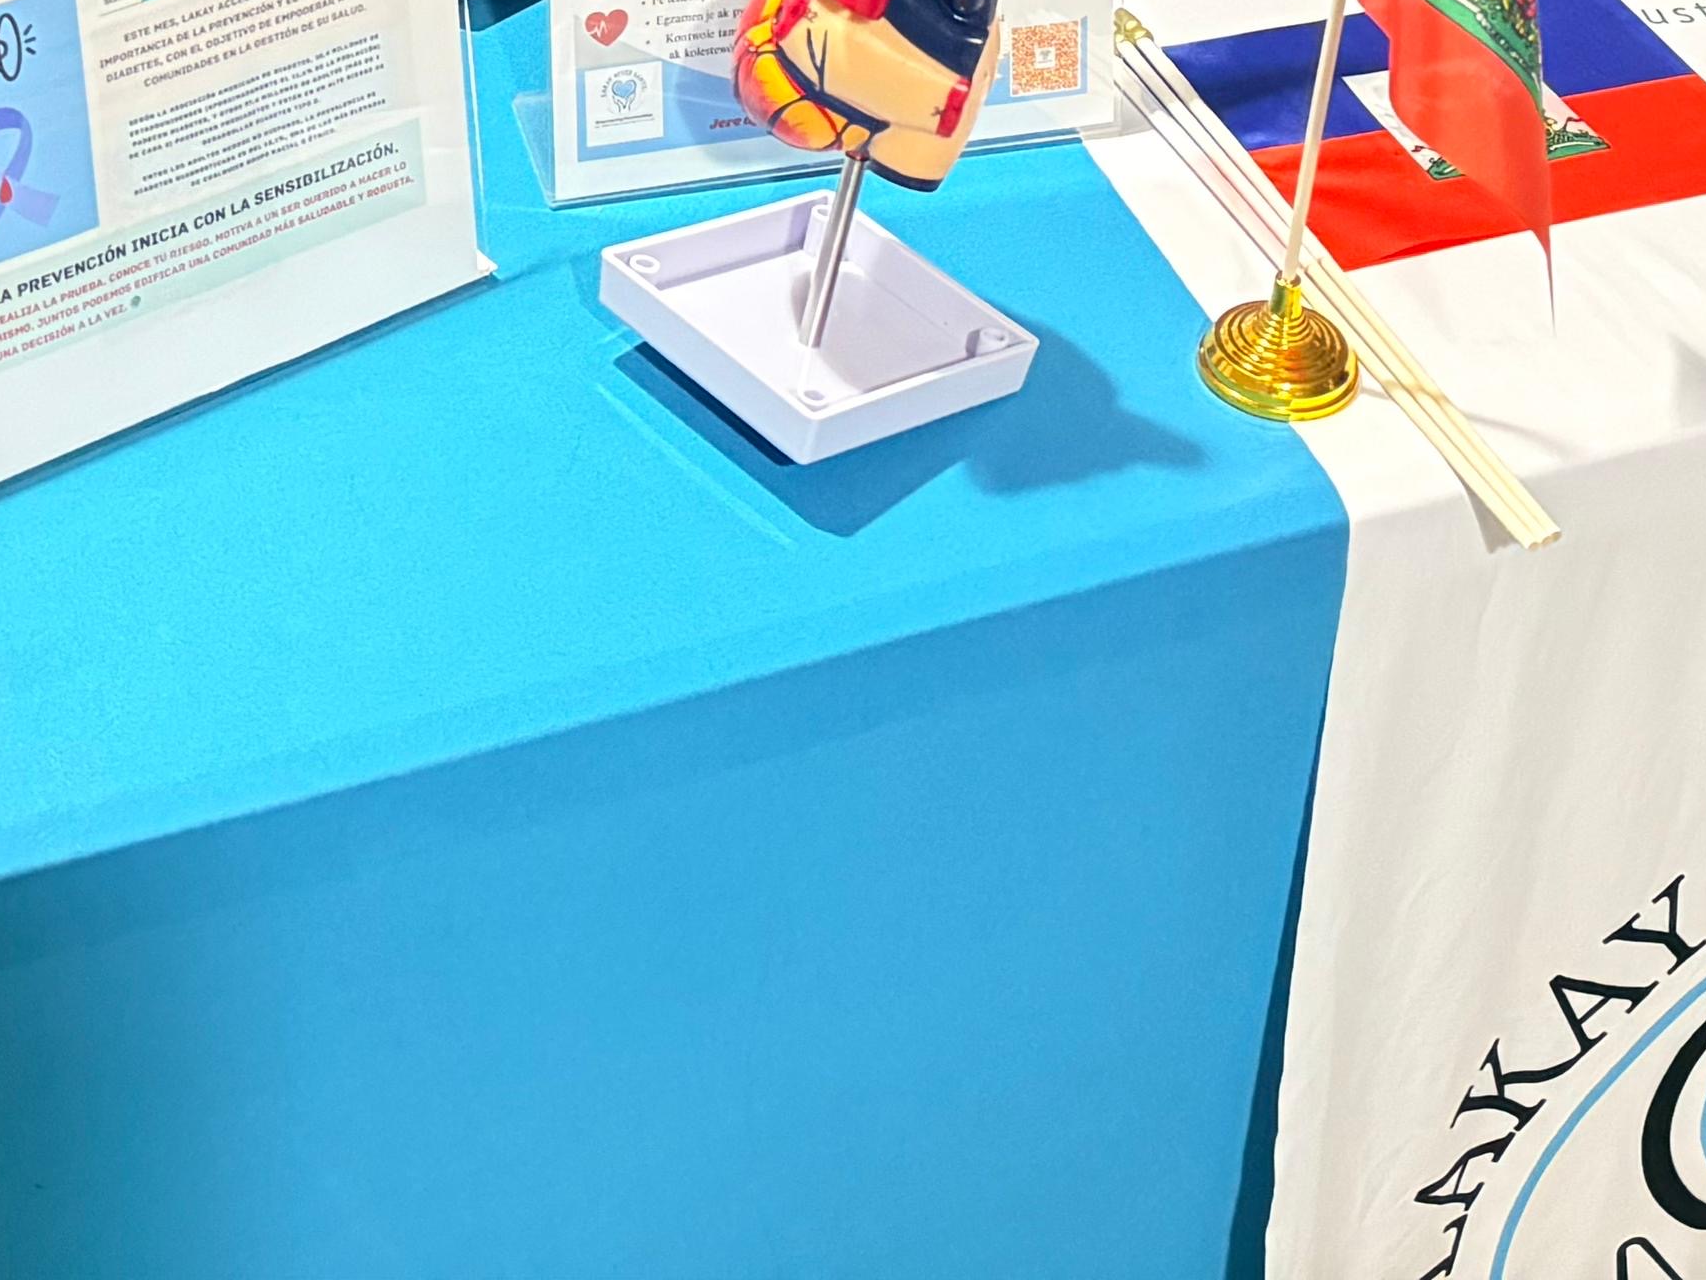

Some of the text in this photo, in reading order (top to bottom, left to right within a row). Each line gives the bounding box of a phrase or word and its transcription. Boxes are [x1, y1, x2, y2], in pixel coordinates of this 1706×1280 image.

[16, 239, 127, 297] PREVENCIÓN
[131, 220, 188, 254] INICIA
[192, 205, 226, 230] CON
[230, 196, 250, 215] LA
[253, 136, 399, 206] SENSIBILIZACIÓN.
